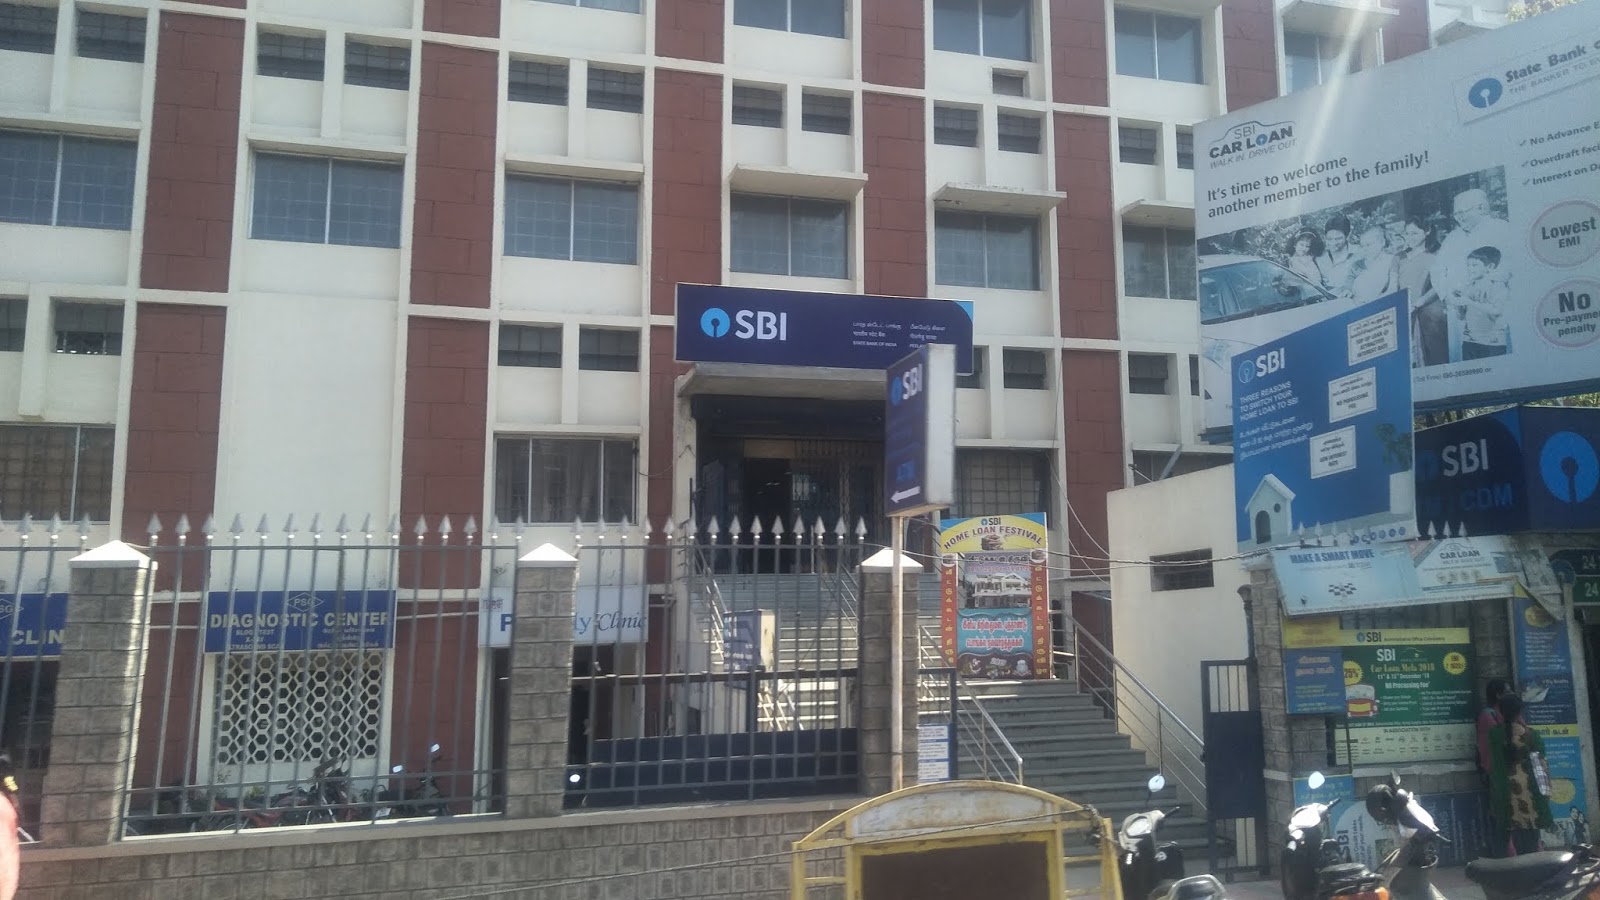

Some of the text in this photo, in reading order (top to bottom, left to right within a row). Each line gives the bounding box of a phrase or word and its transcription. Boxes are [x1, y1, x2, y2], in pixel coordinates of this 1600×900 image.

[1506, 64, 1542, 82] State
[1548, 45, 1586, 66] Bank
[1210, 126, 1292, 158] CAR LOAN
[1234, 125, 1255, 139] SBI
[1530, 137, 1544, 145] No
[1548, 126, 1590, 141] Advance
[1210, 156, 1234, 169] WALK
[1249, 145, 1276, 158] DRIVE
[1530, 150, 1580, 166] Overdraft
[1208, 150, 1428, 218] another member to the family!
[1231, 180, 1260, 195] time
[1264, 176, 1278, 186] to
[1283, 157, 1347, 181] welcome
[1532, 170, 1572, 185] Interest
[1574, 168, 1588, 176] on
[1542, 216, 1596, 240] Lowest
[1559, 236, 1580, 248] EMI
[1558, 291, 1590, 312] No
[736, 310, 788, 341] SBI
[1558, 324, 1596, 337] penalty
[1256, 348, 1285, 377] SBI
[903, 364, 922, 400] SBI
[1240, 380, 1291, 402] THREE REASONS
[1240, 397, 1298, 421] HOME LOAN TO SBI
[1250, 396, 1273, 410] SWITCH
[1274, 390, 1292, 401] YOUR
[1442, 438, 1488, 476] SBI
[1462, 483, 1513, 511] CDM
[988, 517, 1001, 526] SBI
[944, 526, 1042, 549] HOME LOAN FESTIVAL
[1290, 549, 1374, 564] MAKE A SMART MOVE
[1458, 550, 1480, 558] LOAN
[210, 612, 391, 628] DIAGNOSTIC CENTER
[598, 611, 646, 632] Clinic
[12, 630, 64, 645] CLIN
[1366, 632, 1382, 642] SBI
[1376, 648, 1396, 662] SBI
[1370, 664, 1382, 672] Car
[1384, 664, 1400, 672] Loan
[1402, 664, 1418, 672] Mela
[1392, 682, 1420, 690] Processing
